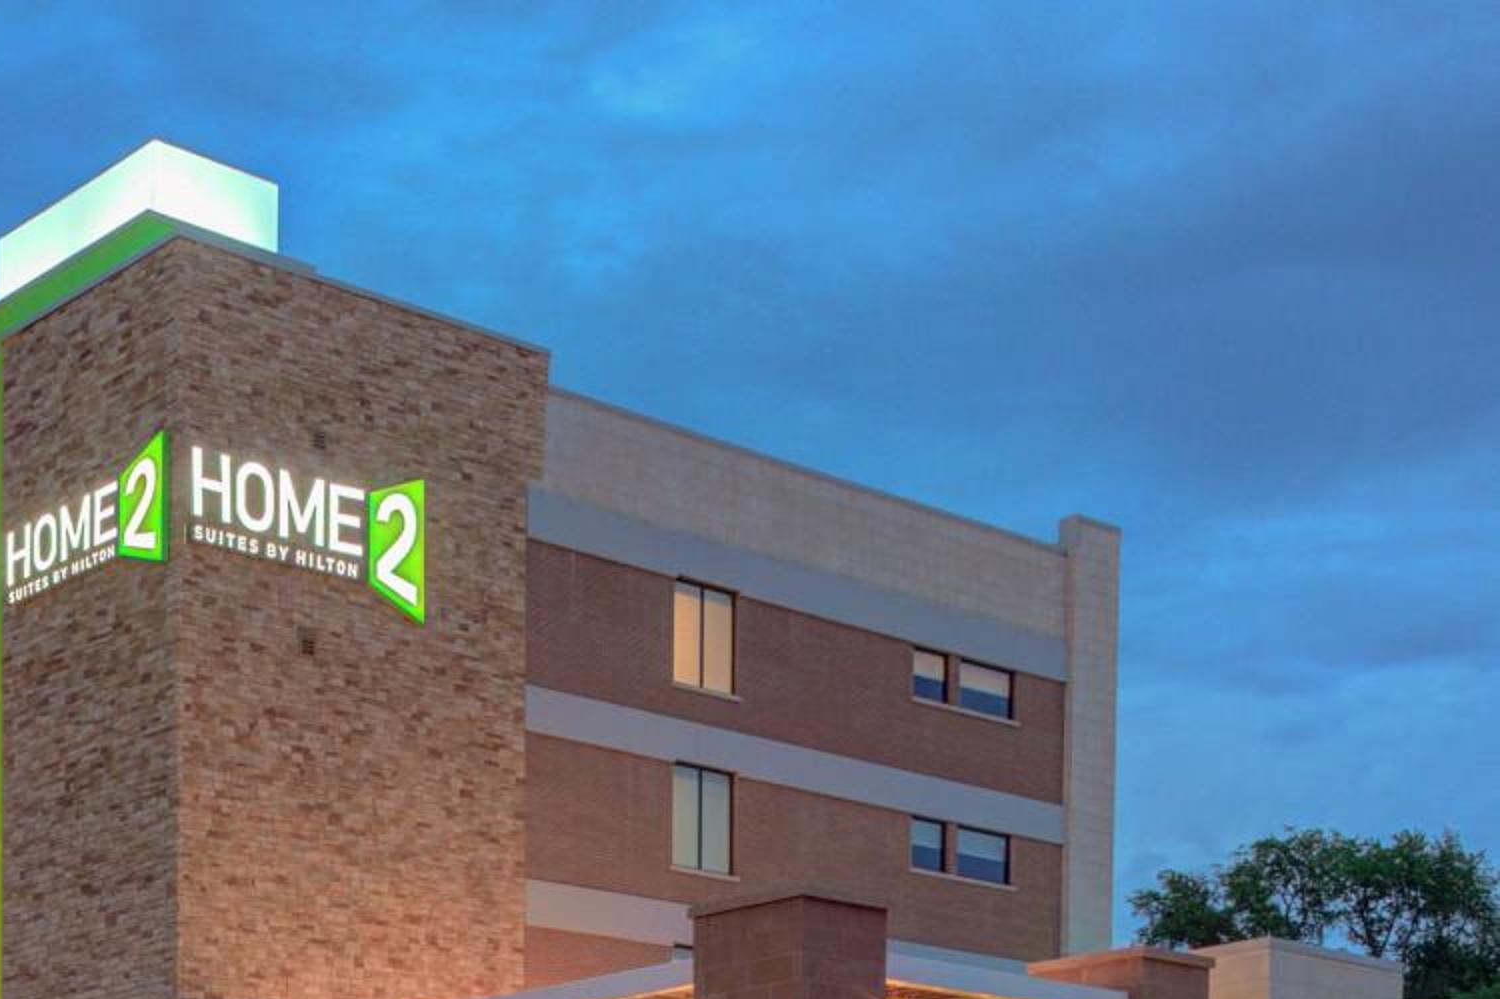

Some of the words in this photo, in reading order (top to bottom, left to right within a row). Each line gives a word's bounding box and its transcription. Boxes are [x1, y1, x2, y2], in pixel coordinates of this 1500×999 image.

[7, 481, 117, 585] HOME
[125, 459, 156, 549] 2
[192, 446, 363, 556] HOME
[377, 494, 416, 606] 2
[194, 525, 258, 553] SUITES
[267, 543, 287, 560] BY
[297, 552, 357, 578] HILTON
[9, 577, 49, 603] SUITES
[53, 570, 68, 585] BY
[72, 546, 115, 574] HILTON
